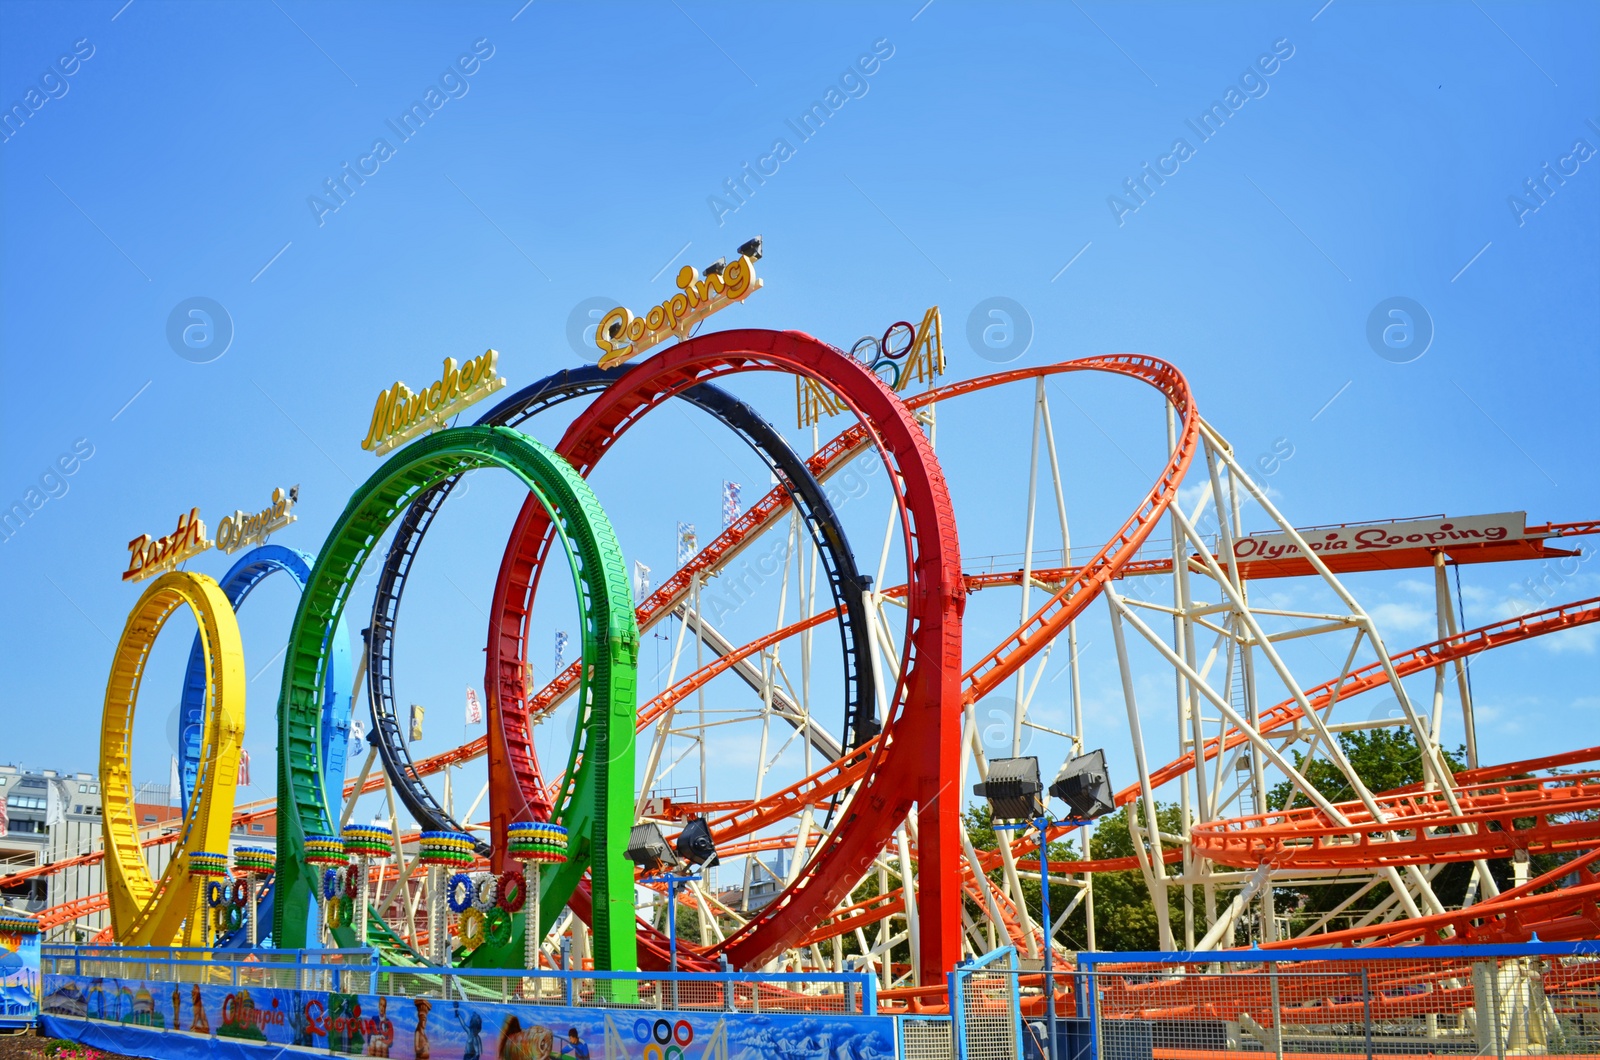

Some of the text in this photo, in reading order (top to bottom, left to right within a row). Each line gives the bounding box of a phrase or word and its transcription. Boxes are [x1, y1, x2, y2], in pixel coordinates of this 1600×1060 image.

[596, 254, 753, 369] Looping
[361, 349, 496, 450] München
[122, 507, 204, 581] Barth
[216, 487, 289, 550] Olympia
[1354, 523, 1508, 550] Looping
[222, 993, 394, 1044] Olympia Looping
